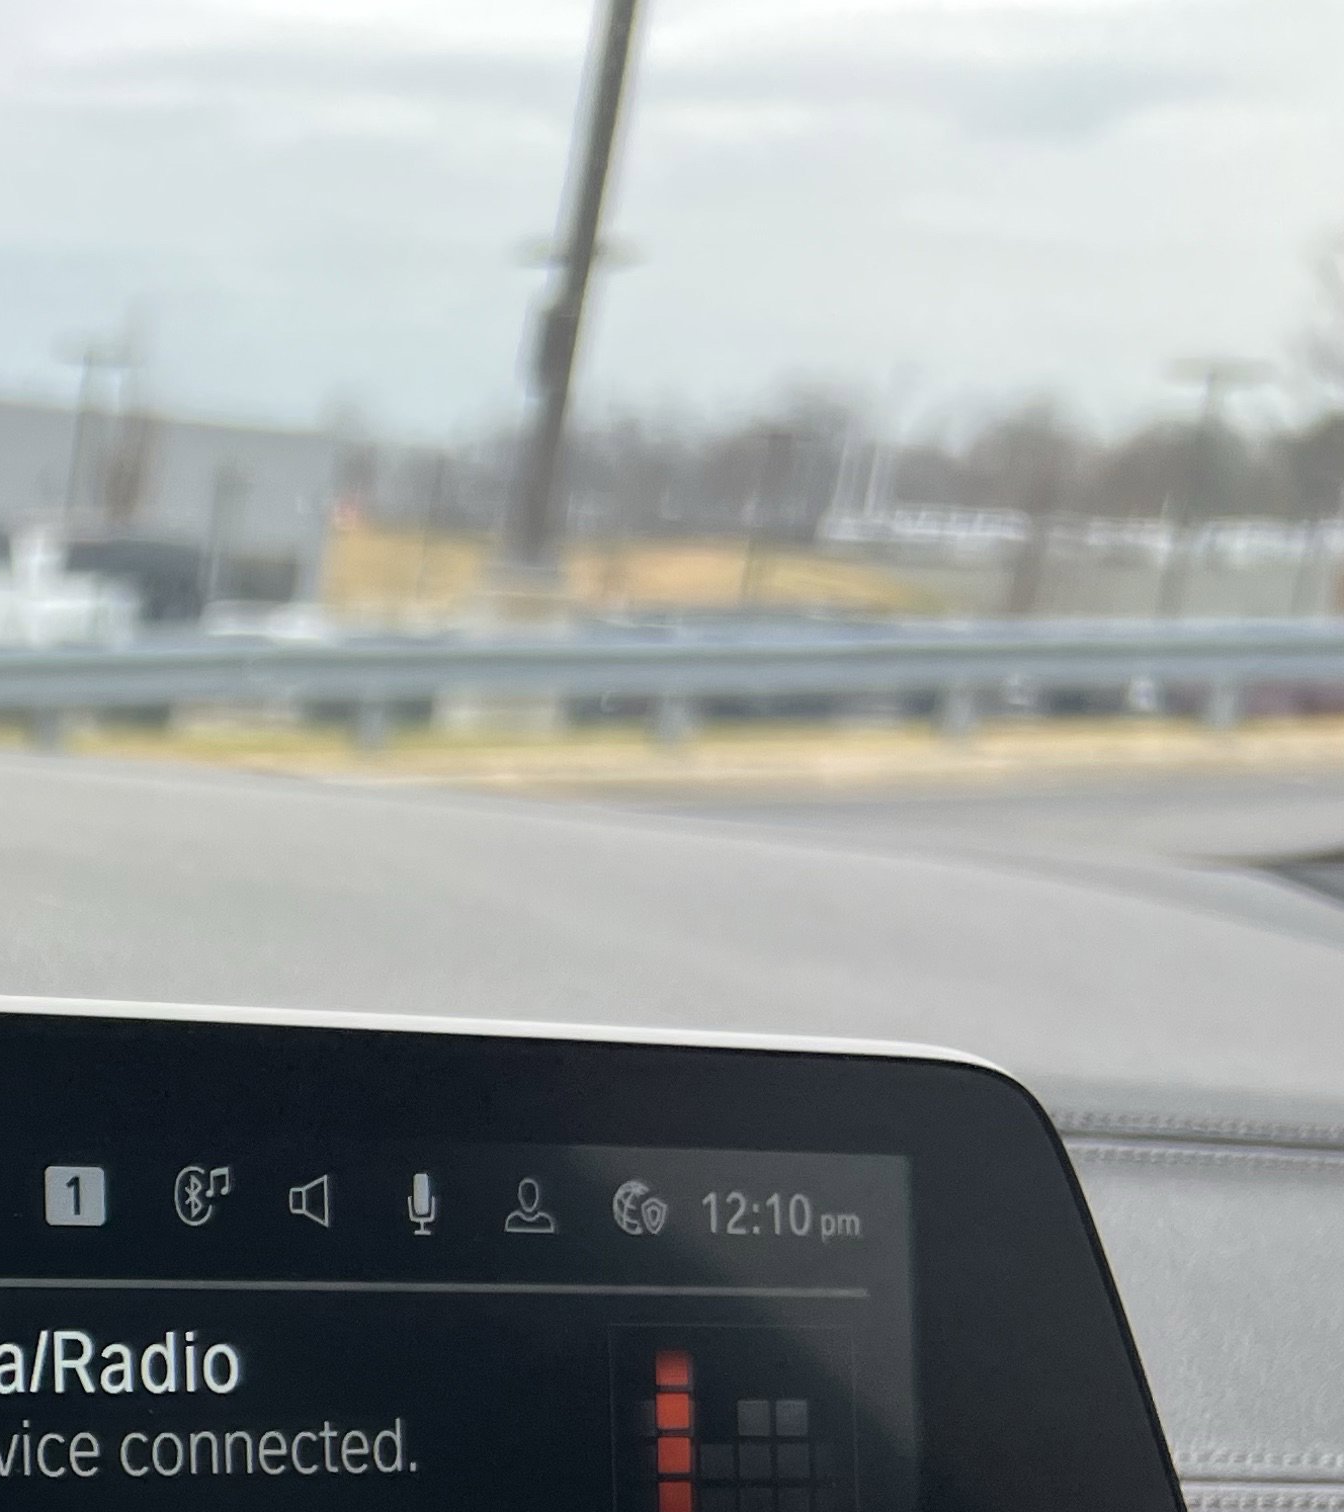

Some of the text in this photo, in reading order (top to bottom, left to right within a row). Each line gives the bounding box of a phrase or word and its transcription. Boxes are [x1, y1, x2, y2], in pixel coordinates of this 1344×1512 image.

[65, 1175, 81, 1216] 1
[702, 1191, 861, 1243] 12:10 pm
[118, 1417, 419, 1477] connected.
